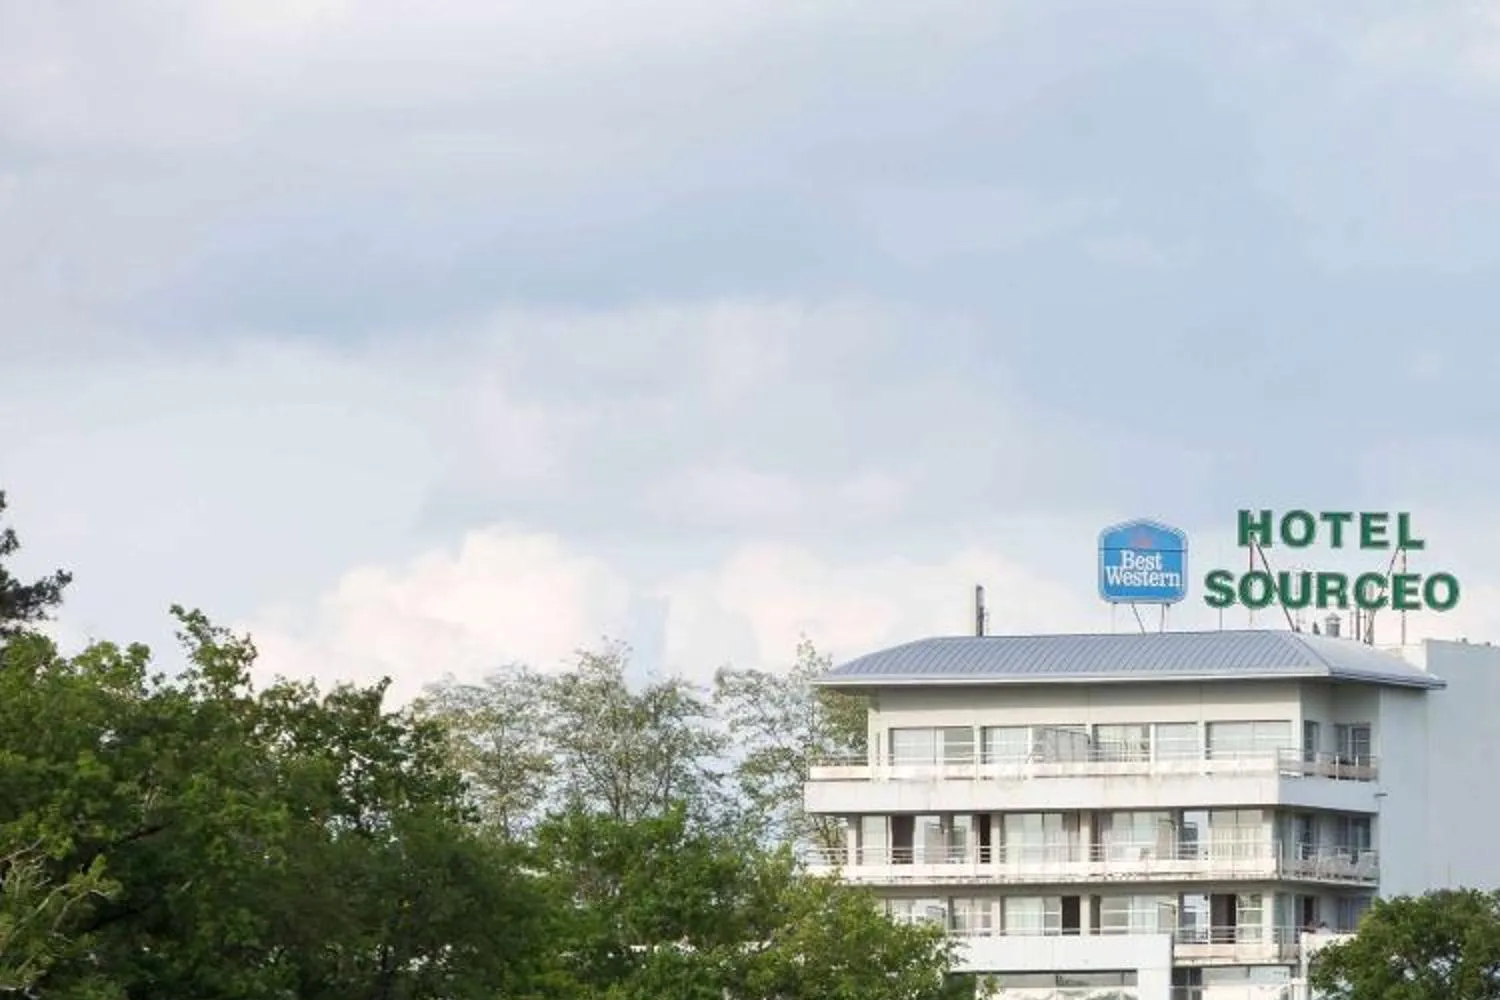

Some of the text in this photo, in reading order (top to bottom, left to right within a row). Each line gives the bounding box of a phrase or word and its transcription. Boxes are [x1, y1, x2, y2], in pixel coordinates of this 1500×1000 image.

[1238, 510, 1424, 549] HOTEL
[1104, 565, 1182, 586] Western
[1120, 550, 1162, 571] Best
[1204, 569, 1459, 610] SOURCEO
